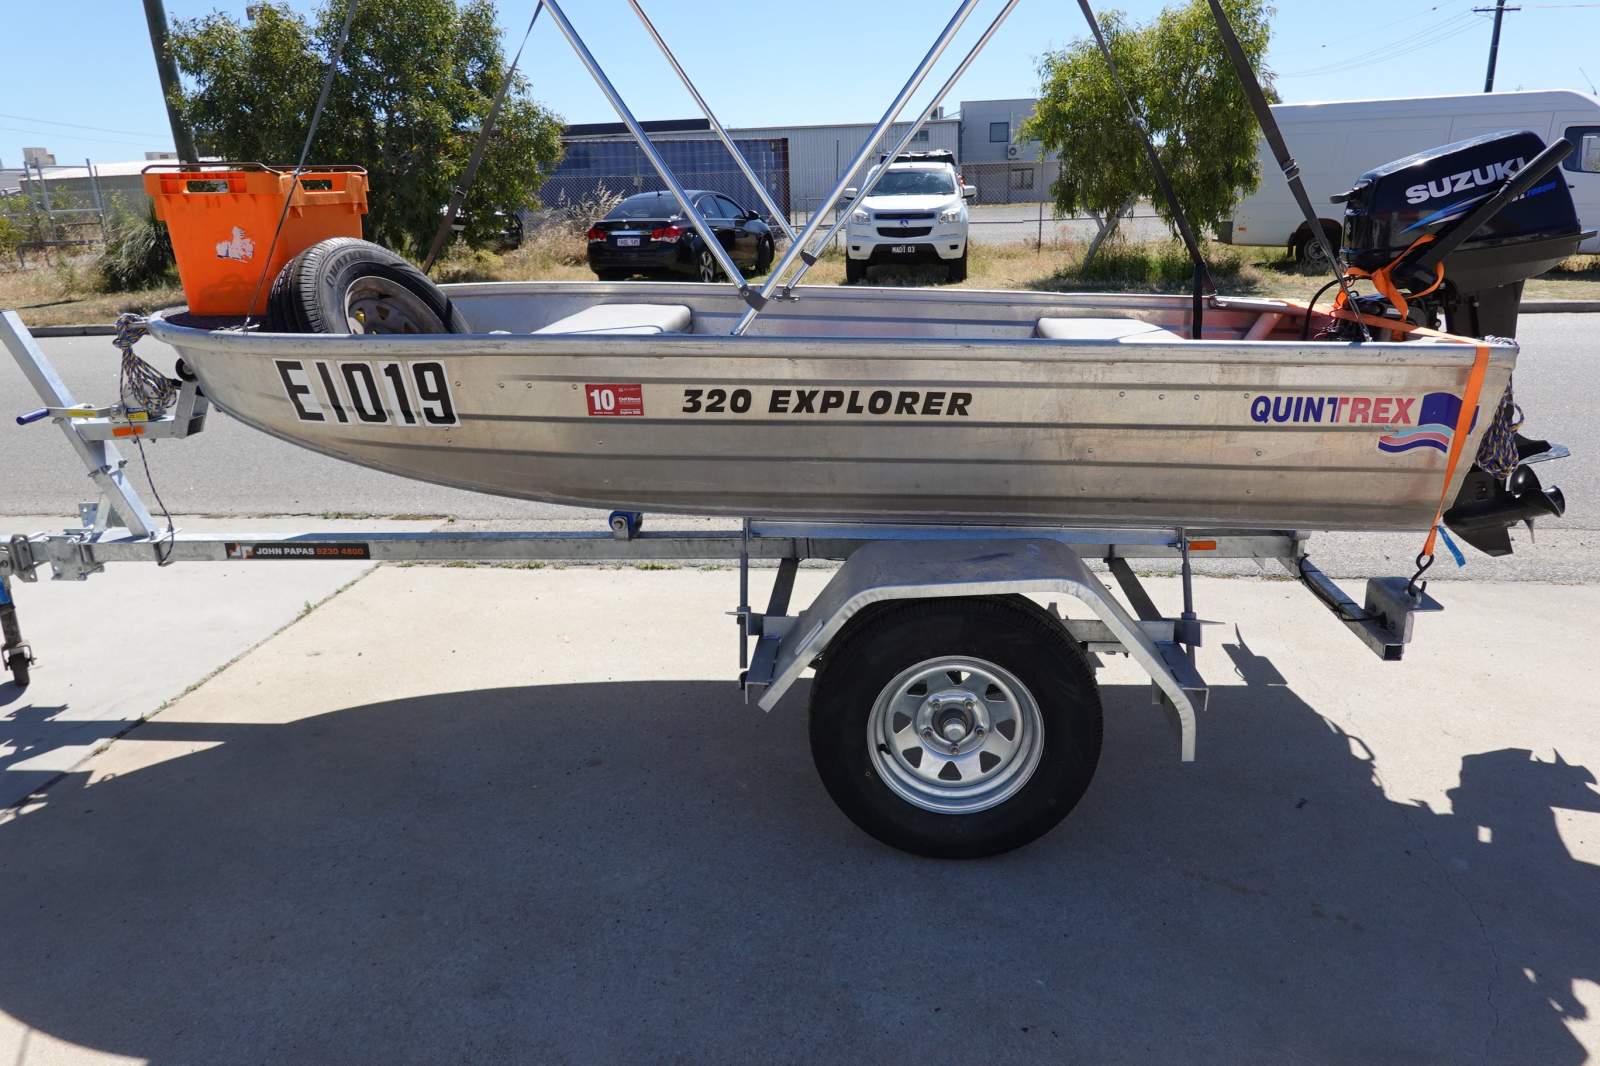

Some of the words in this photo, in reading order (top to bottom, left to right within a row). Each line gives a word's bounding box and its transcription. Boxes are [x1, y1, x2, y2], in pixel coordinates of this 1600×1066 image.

[1405, 157, 1526, 205] SUZUKI
[590, 389, 615, 411] 10
[682, 389, 752, 414] 320
[768, 390, 973, 416] EXPLORER
[1250, 394, 1416, 424] QUINTREX
[256, 547, 282, 555] JOHN
[284, 547, 315, 555] PAPAS
